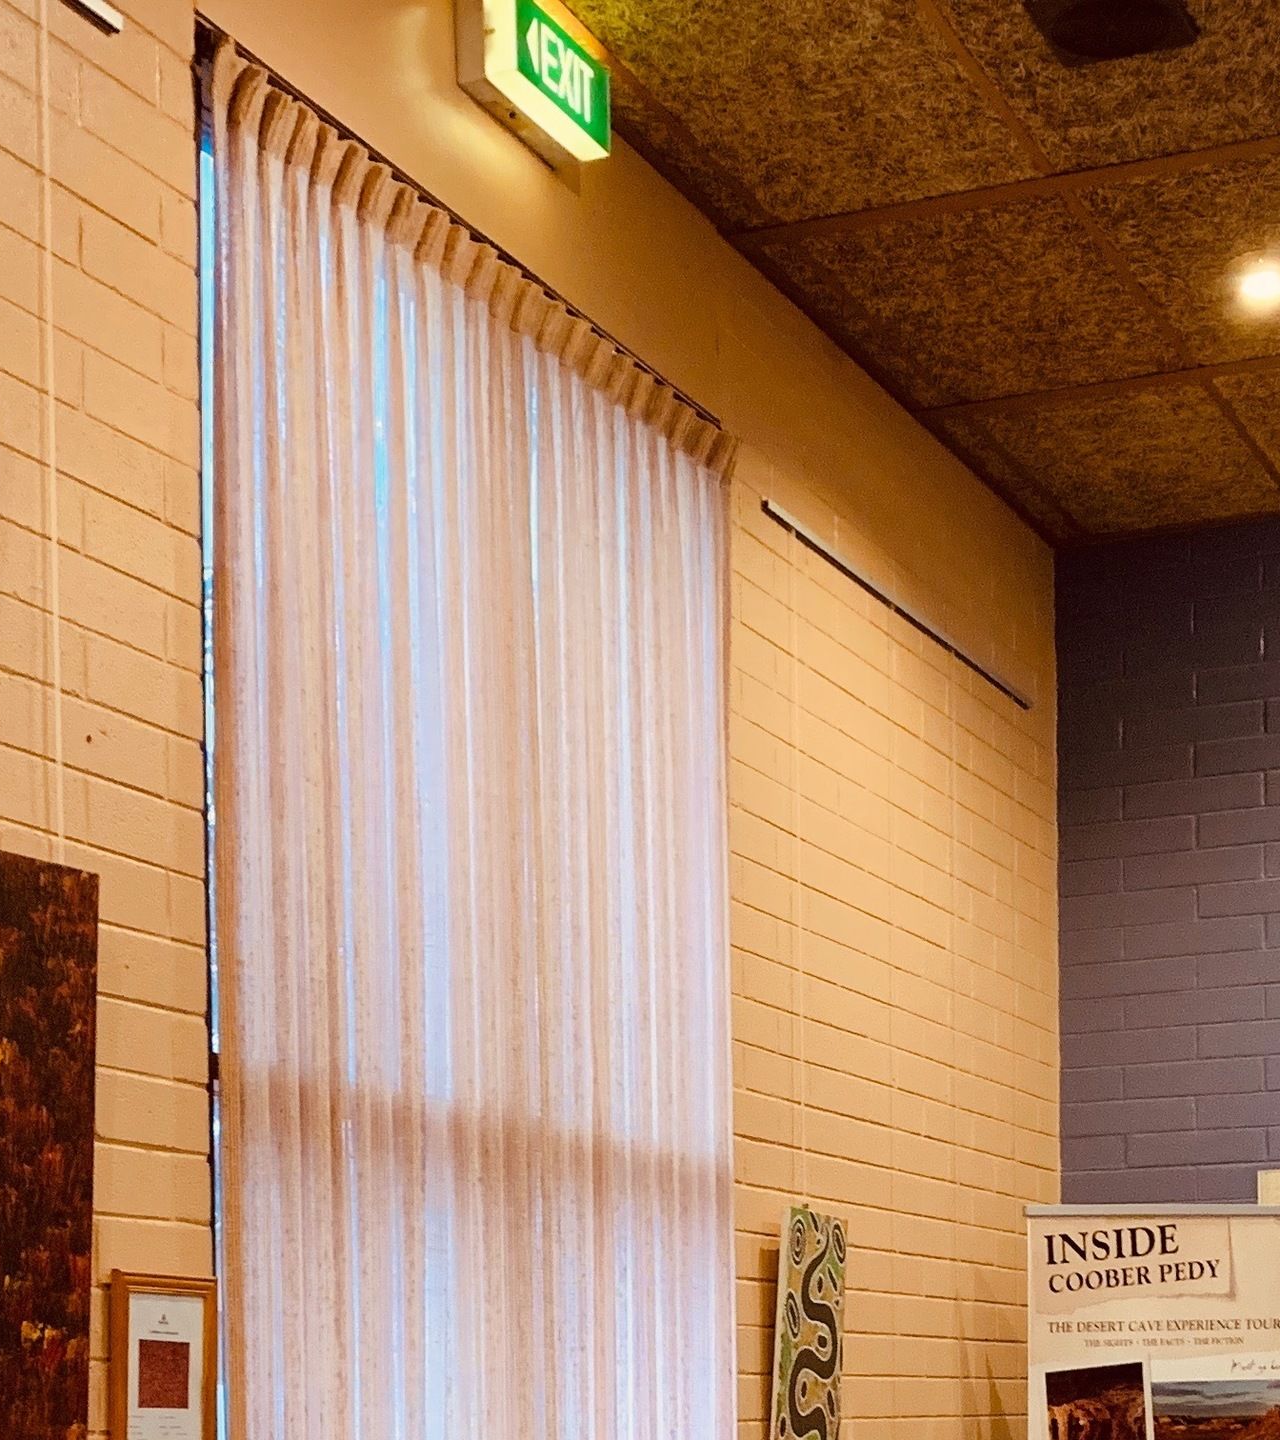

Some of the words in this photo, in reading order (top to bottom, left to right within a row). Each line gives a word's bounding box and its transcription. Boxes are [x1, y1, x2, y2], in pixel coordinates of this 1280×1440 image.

[540, 22, 595, 124] EXIT
[1044, 1224, 1180, 1266] INSIDE
[1048, 1265, 1152, 1294] COOBER
[1159, 1259, 1221, 1284] PEDY
[1047, 1321, 1072, 1334] THE
[1077, 1320, 1123, 1334] DESERT
[1128, 1319, 1163, 1333] CAVE
[1167, 1318, 1241, 1332] EXPERIENCE
